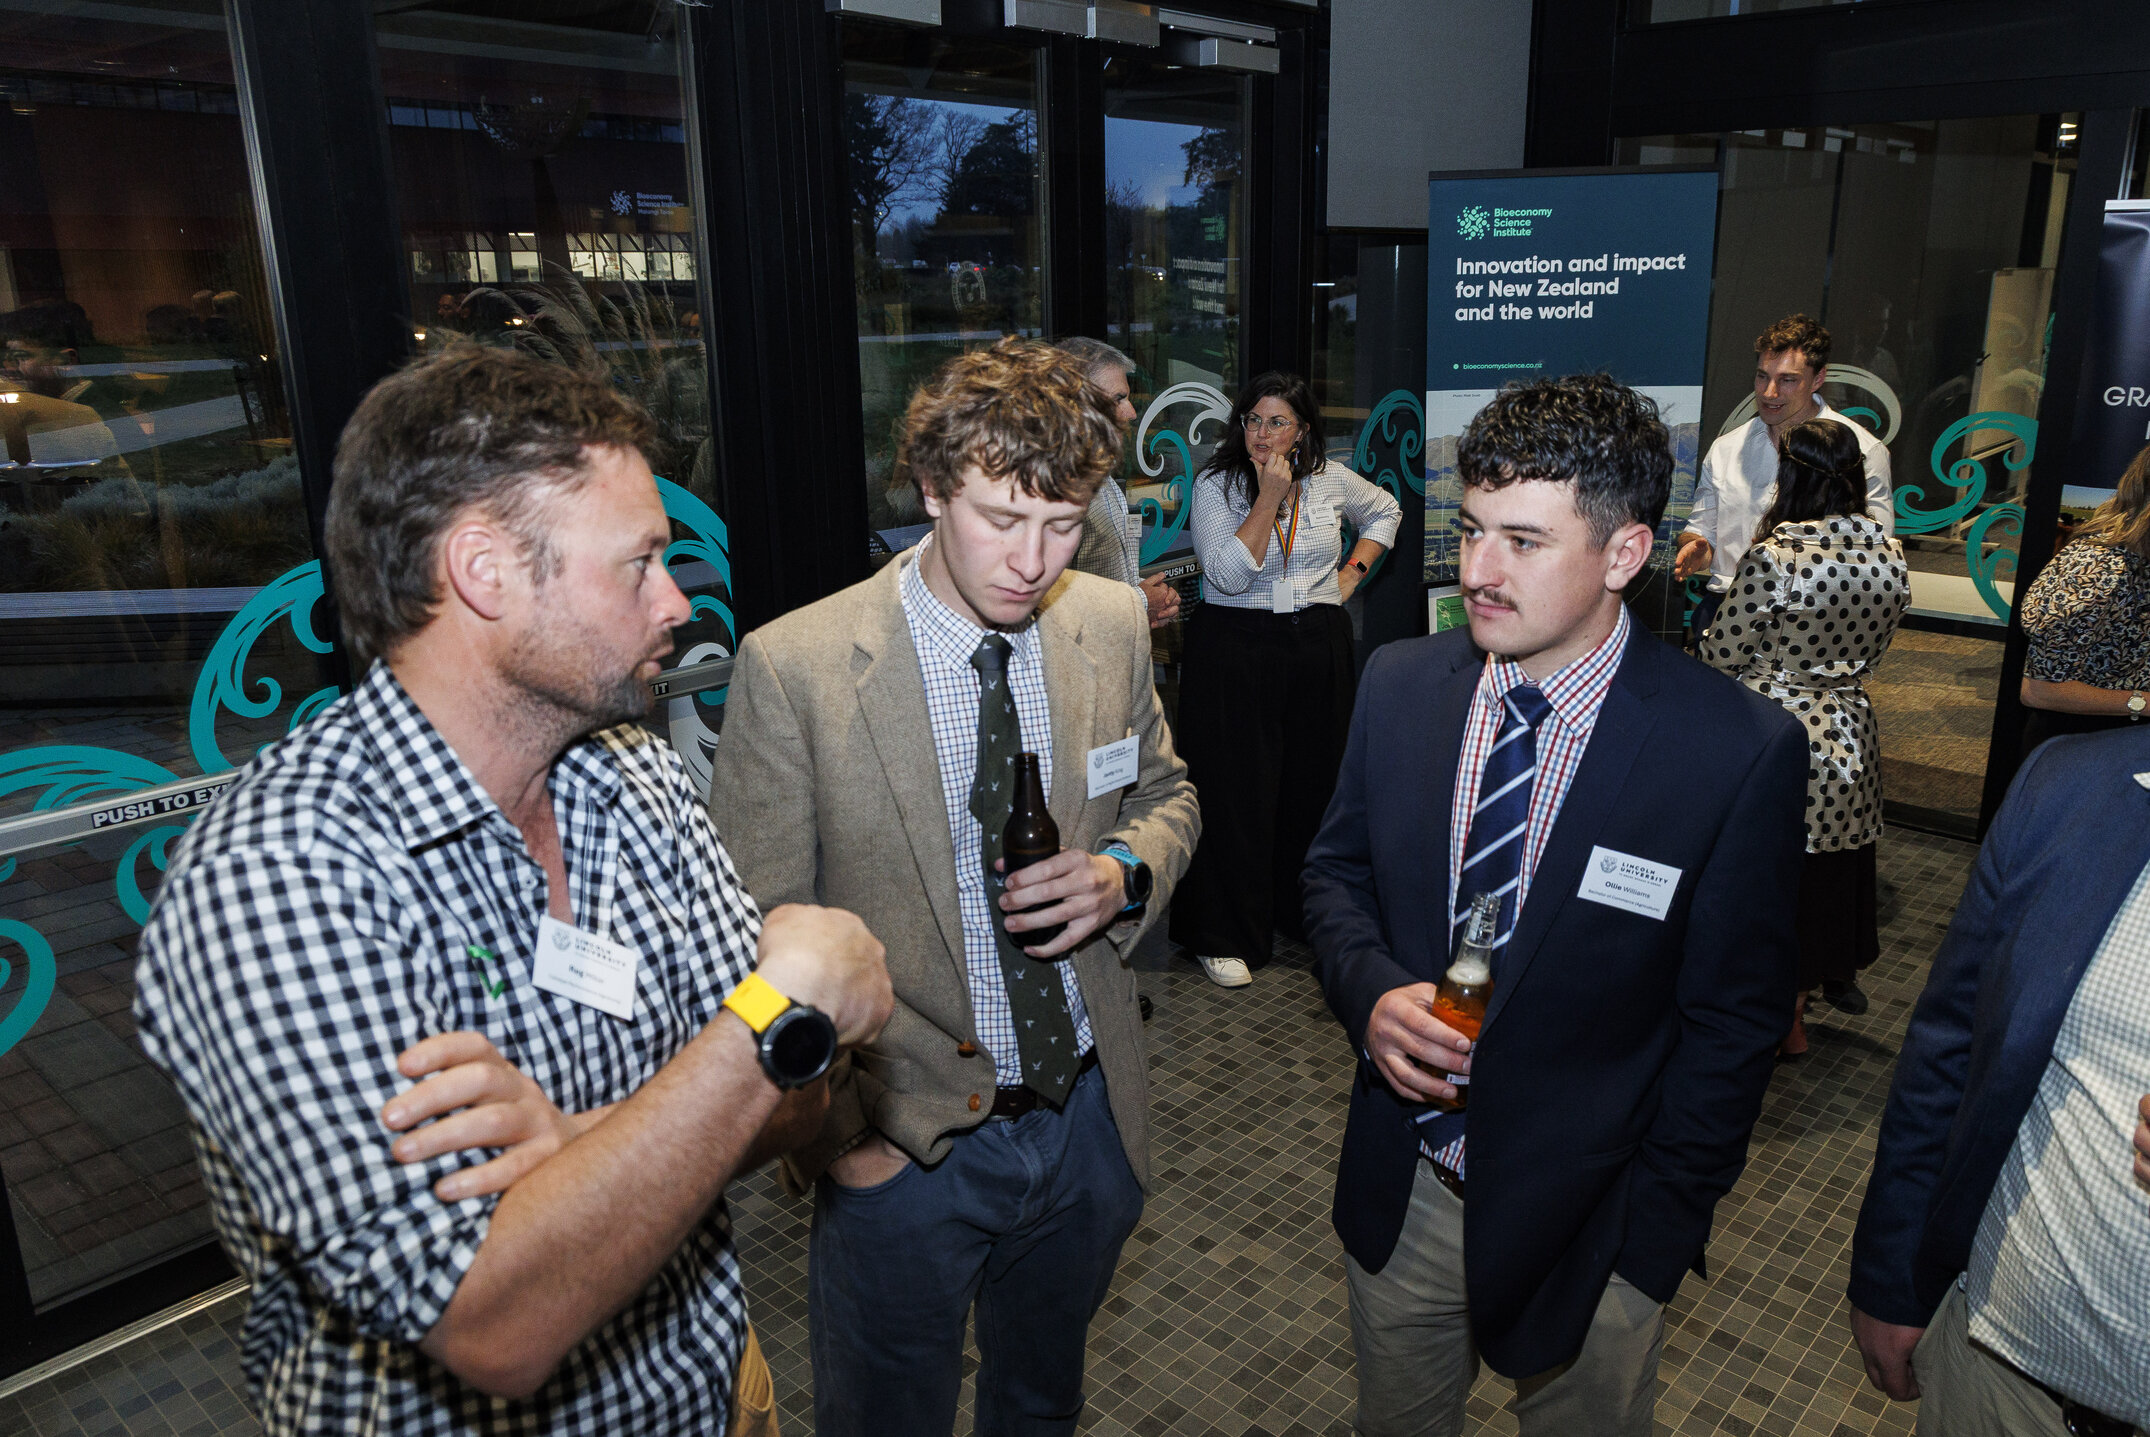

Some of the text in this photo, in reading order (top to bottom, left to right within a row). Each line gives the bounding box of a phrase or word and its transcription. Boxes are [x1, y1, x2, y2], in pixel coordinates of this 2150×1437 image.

[1494, 208, 1552, 218] Bioeconomy
[1494, 218, 1531, 227] Science
[1493, 228, 1532, 237] Institute
[1456, 253, 1686, 275] Innovation and impact
[1455, 277, 1619, 298] for New Zealand
[1455, 301, 1593, 321] and the world
[1164, 566, 1183, 578] PUSH
[1185, 563, 1196, 573] TO
[93, 800, 155, 828] PUSH
[159, 794, 190, 810] TO
[1620, 867, 1668, 884] UNIVERSITY
[1622, 862, 1656, 875] LINCOLN
[1605, 881, 1651, 899] Ollie Williams
